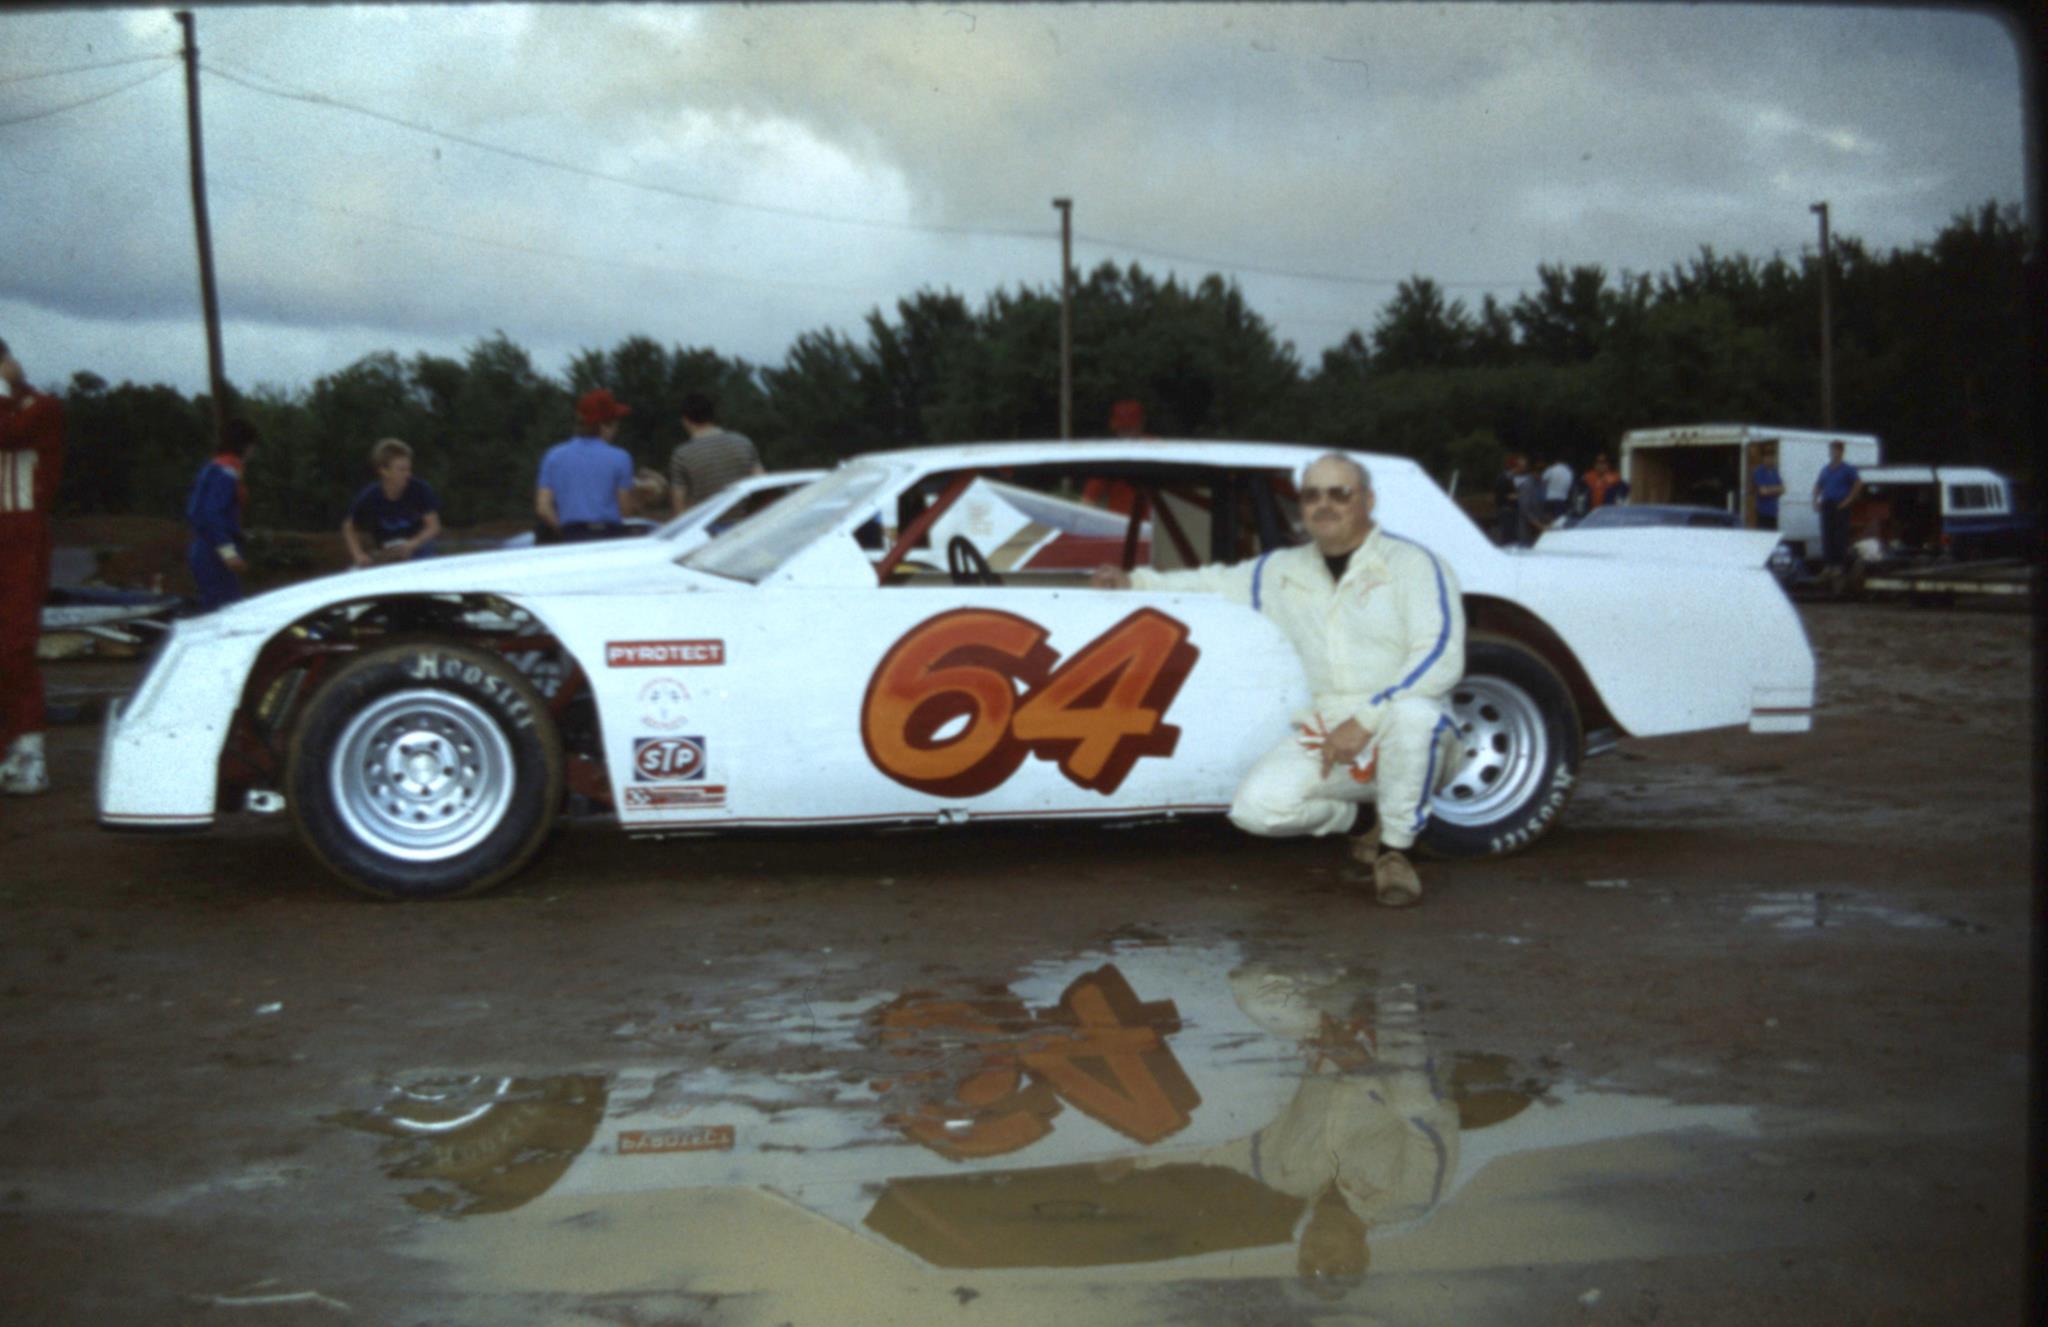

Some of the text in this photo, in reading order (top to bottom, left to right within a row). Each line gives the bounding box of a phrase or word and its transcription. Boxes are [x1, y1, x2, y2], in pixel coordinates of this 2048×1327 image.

[607, 645, 721, 661] PYROTECT
[861, 607, 1201, 797] 64
[643, 742, 696, 772] STP
